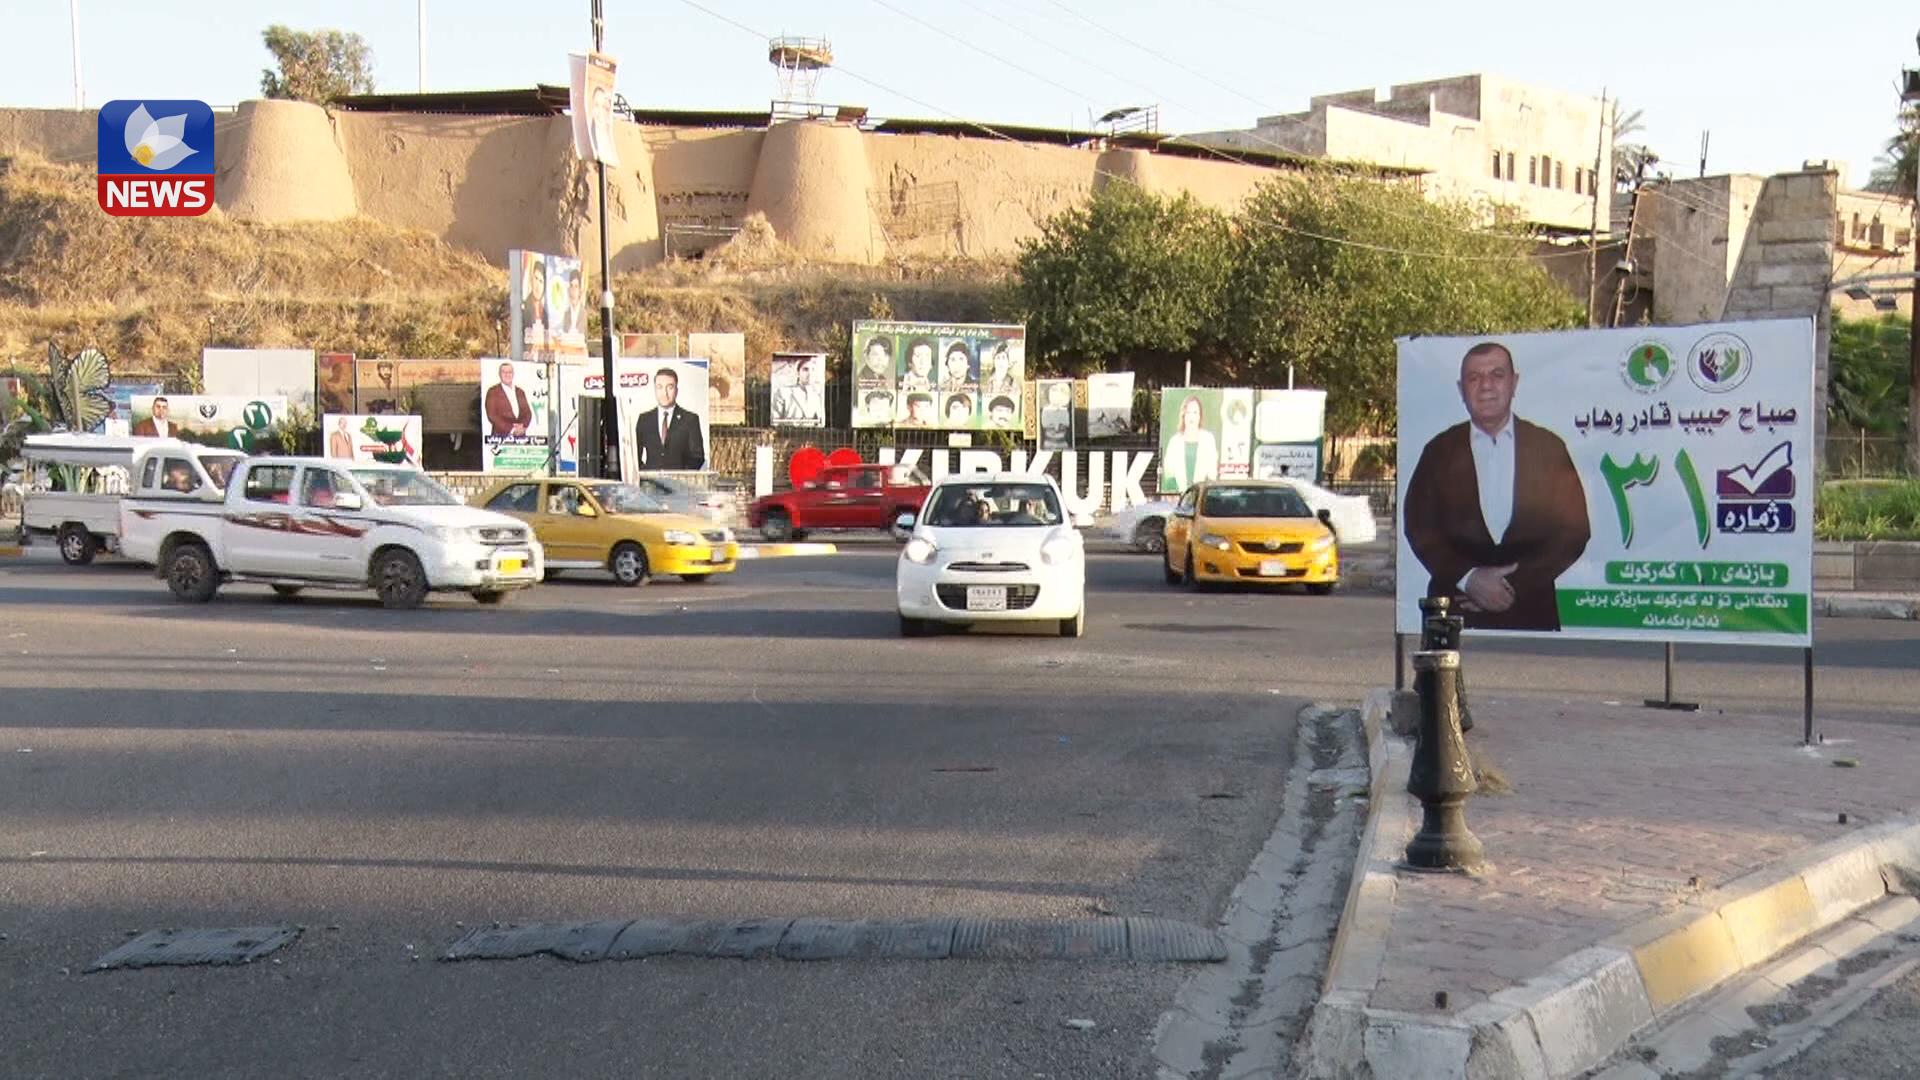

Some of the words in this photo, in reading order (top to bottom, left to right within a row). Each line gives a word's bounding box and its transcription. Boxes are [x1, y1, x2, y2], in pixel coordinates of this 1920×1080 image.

[1574, 406, 1623, 435] وهاب
[1628, 401, 1672, 434] قادر
[1678, 405, 1730, 434] حبيب
[1738, 401, 1797, 434] صباح
[1600, 447, 1711, 549] ٣١
